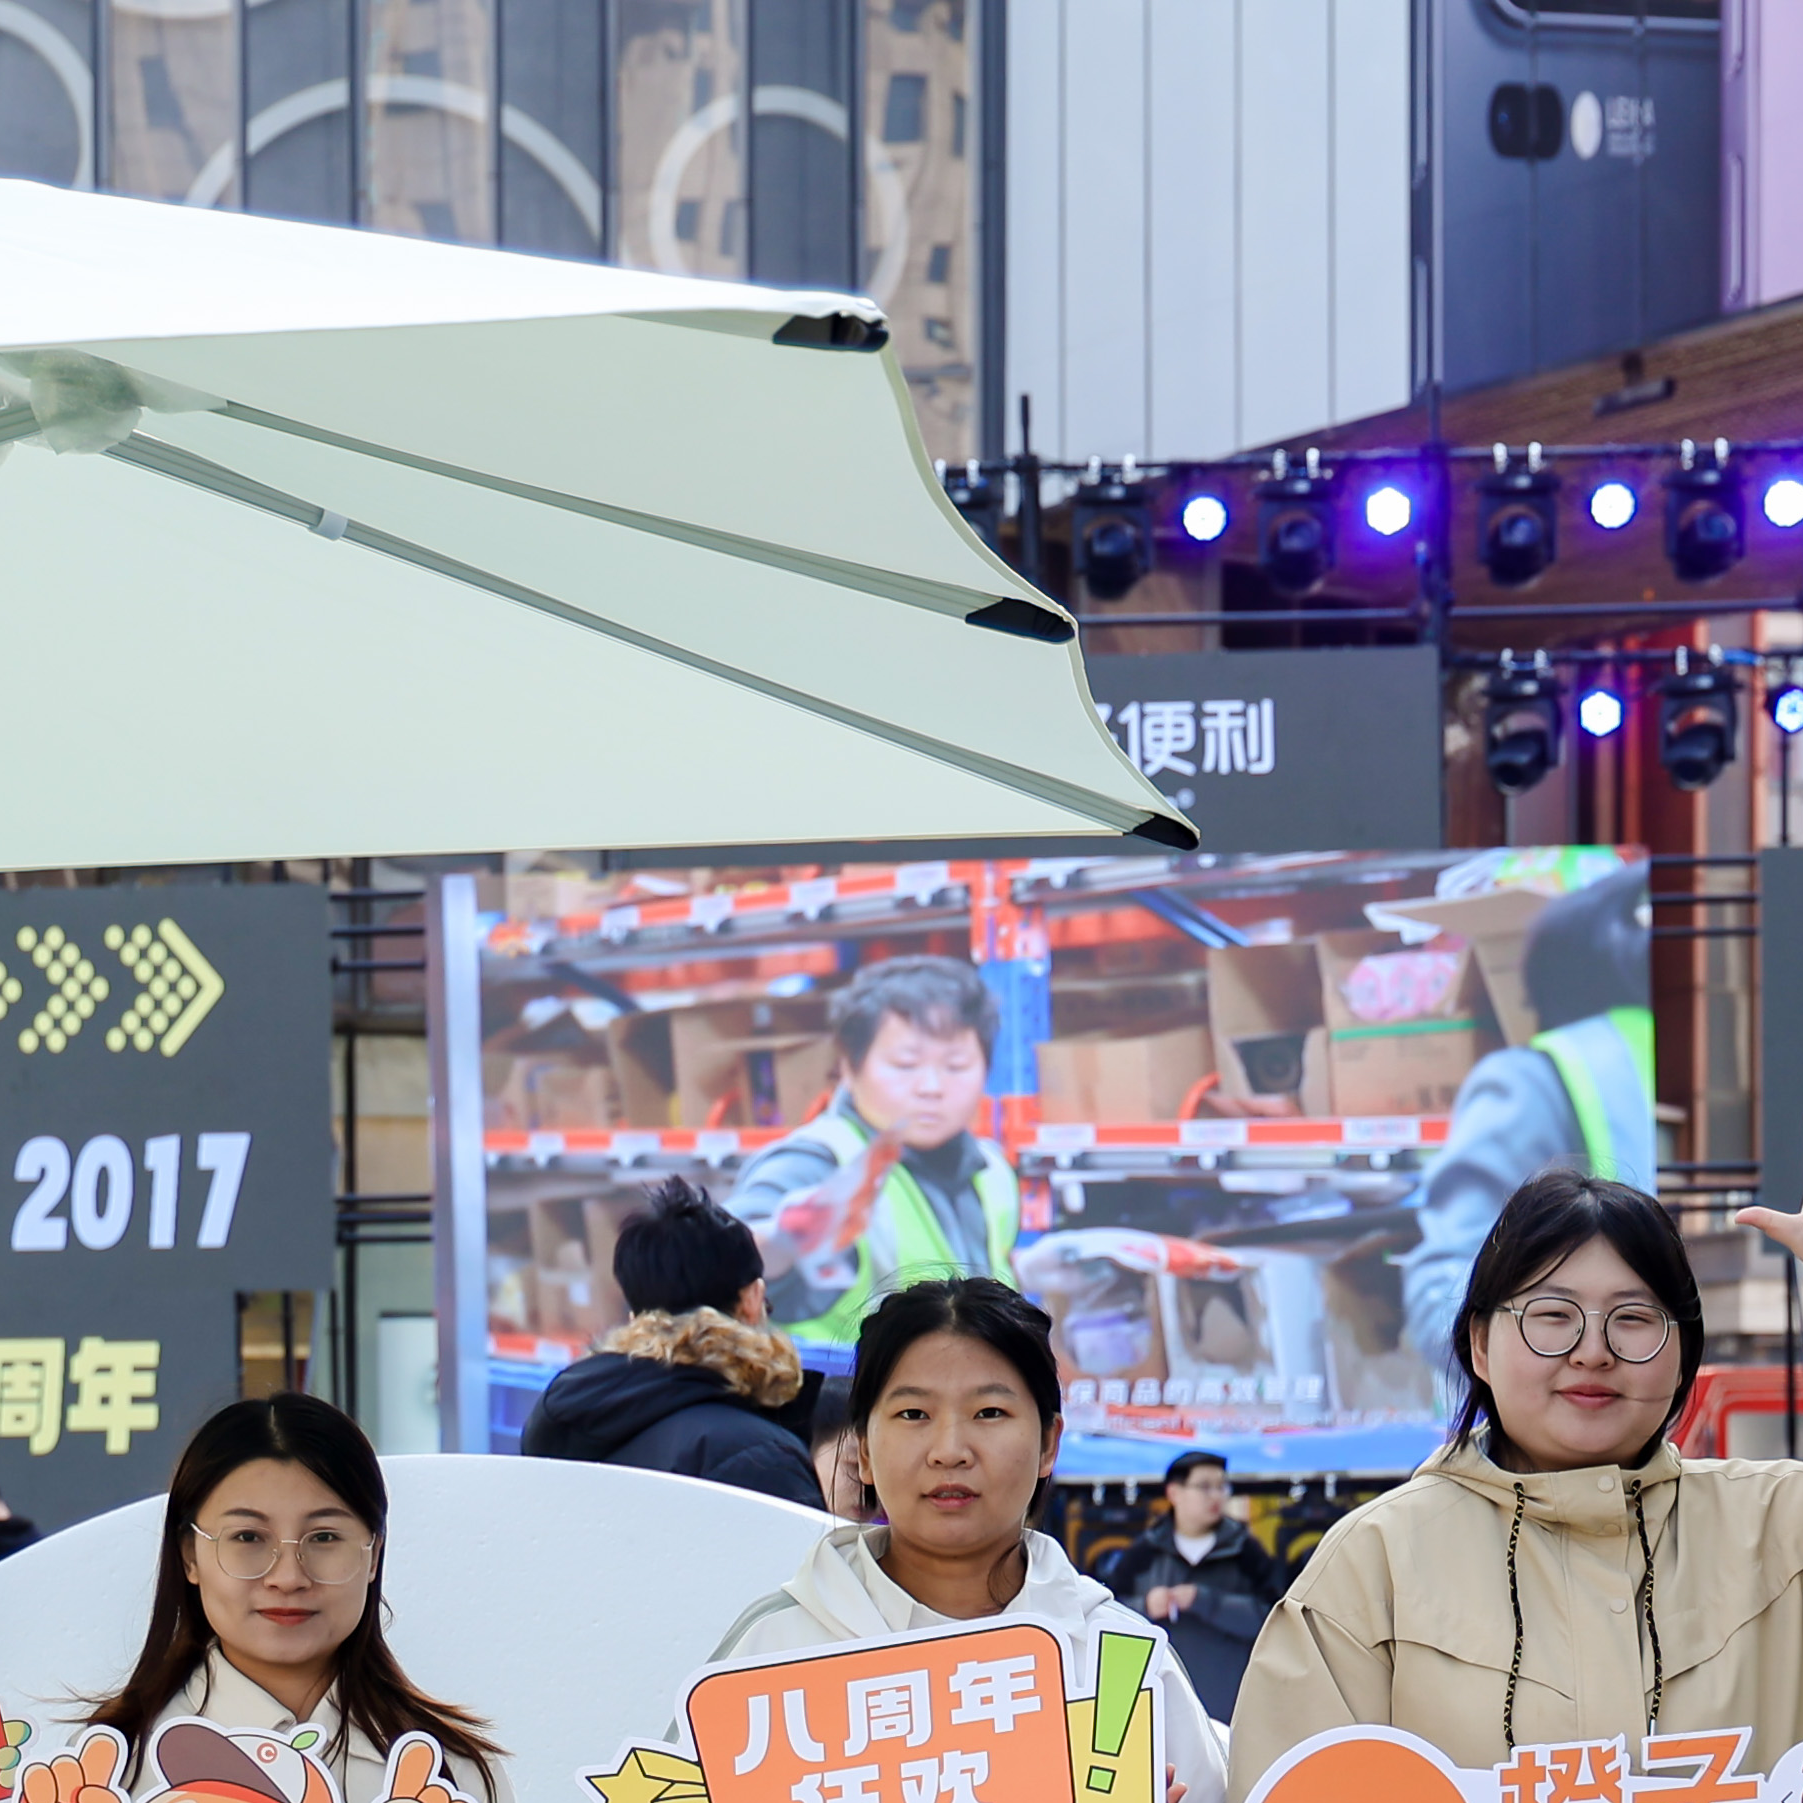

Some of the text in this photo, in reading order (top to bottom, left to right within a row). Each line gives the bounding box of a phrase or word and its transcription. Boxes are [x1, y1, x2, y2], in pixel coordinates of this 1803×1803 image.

[11, 1131, 252, 1252] 2017
[734, 1654, 1042, 1776] 八周年
